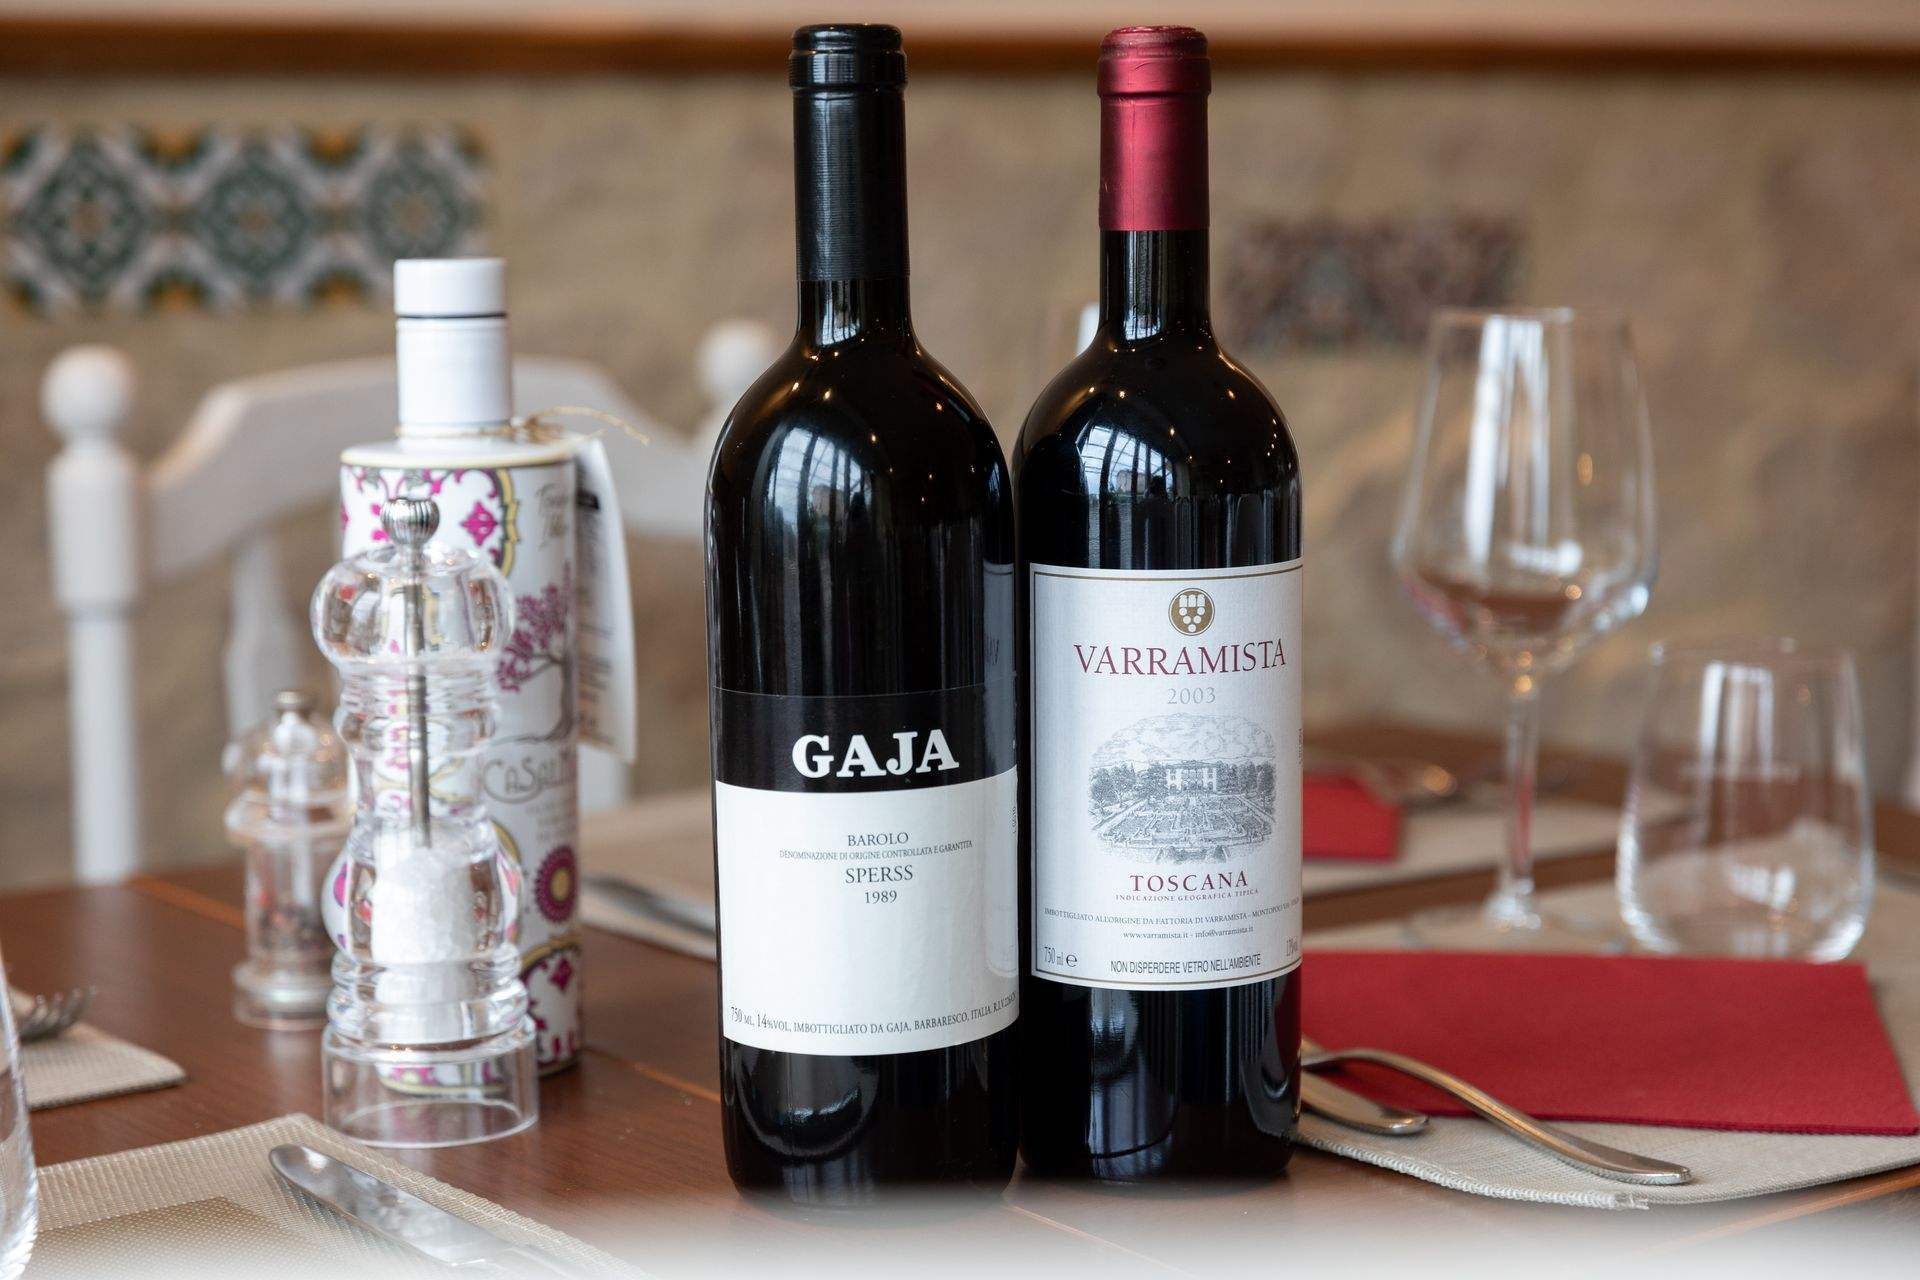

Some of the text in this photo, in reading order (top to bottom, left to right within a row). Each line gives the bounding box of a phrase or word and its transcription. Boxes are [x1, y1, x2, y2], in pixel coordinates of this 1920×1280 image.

[1074, 638, 1287, 676] VARRAMISTA
[1167, 686, 1216, 705] 2003
[791, 728, 960, 779] GAJA
[847, 831, 909, 847] BAROLO
[779, 849, 838, 861] DENOMINAZIONE
[840, 851, 848, 861] DI
[849, 850, 881, 860] ORIGINE
[882, 846, 933, 859] CONTROLLATA
[939, 839, 973, 854] GARANTITA
[845, 864, 914, 884] SPERSS
[1130, 870, 1248, 892] TOSCANA
[865, 889, 898, 905] 1989
[1115, 888, 1259, 902] INDICAZIONE GEOGRAFICA TIPICA
[1044, 907, 1094, 921] IMBOTTIGLIATO
[1095, 914, 1141, 925] ALL'ORIGINE
[1143, 917, 1155, 925] DA
[1195, 916, 1203, 925] DI
[1204, 913, 1248, 924] VARRAMISTA
[1123, 931, 1188, 940] www.varramista.it
[1195, 924, 1254, 939] info@varramista.it
[1110, 953, 1261, 974] NON DISPERDERE VETRO NELL'AMBIENTE
[731, 1006, 743, 1023] 750
[794, 1021, 868, 1034] IMBOTTIGLIATO
[870, 1023, 884, 1033] DA
[886, 1022, 912, 1034] GAJA,
